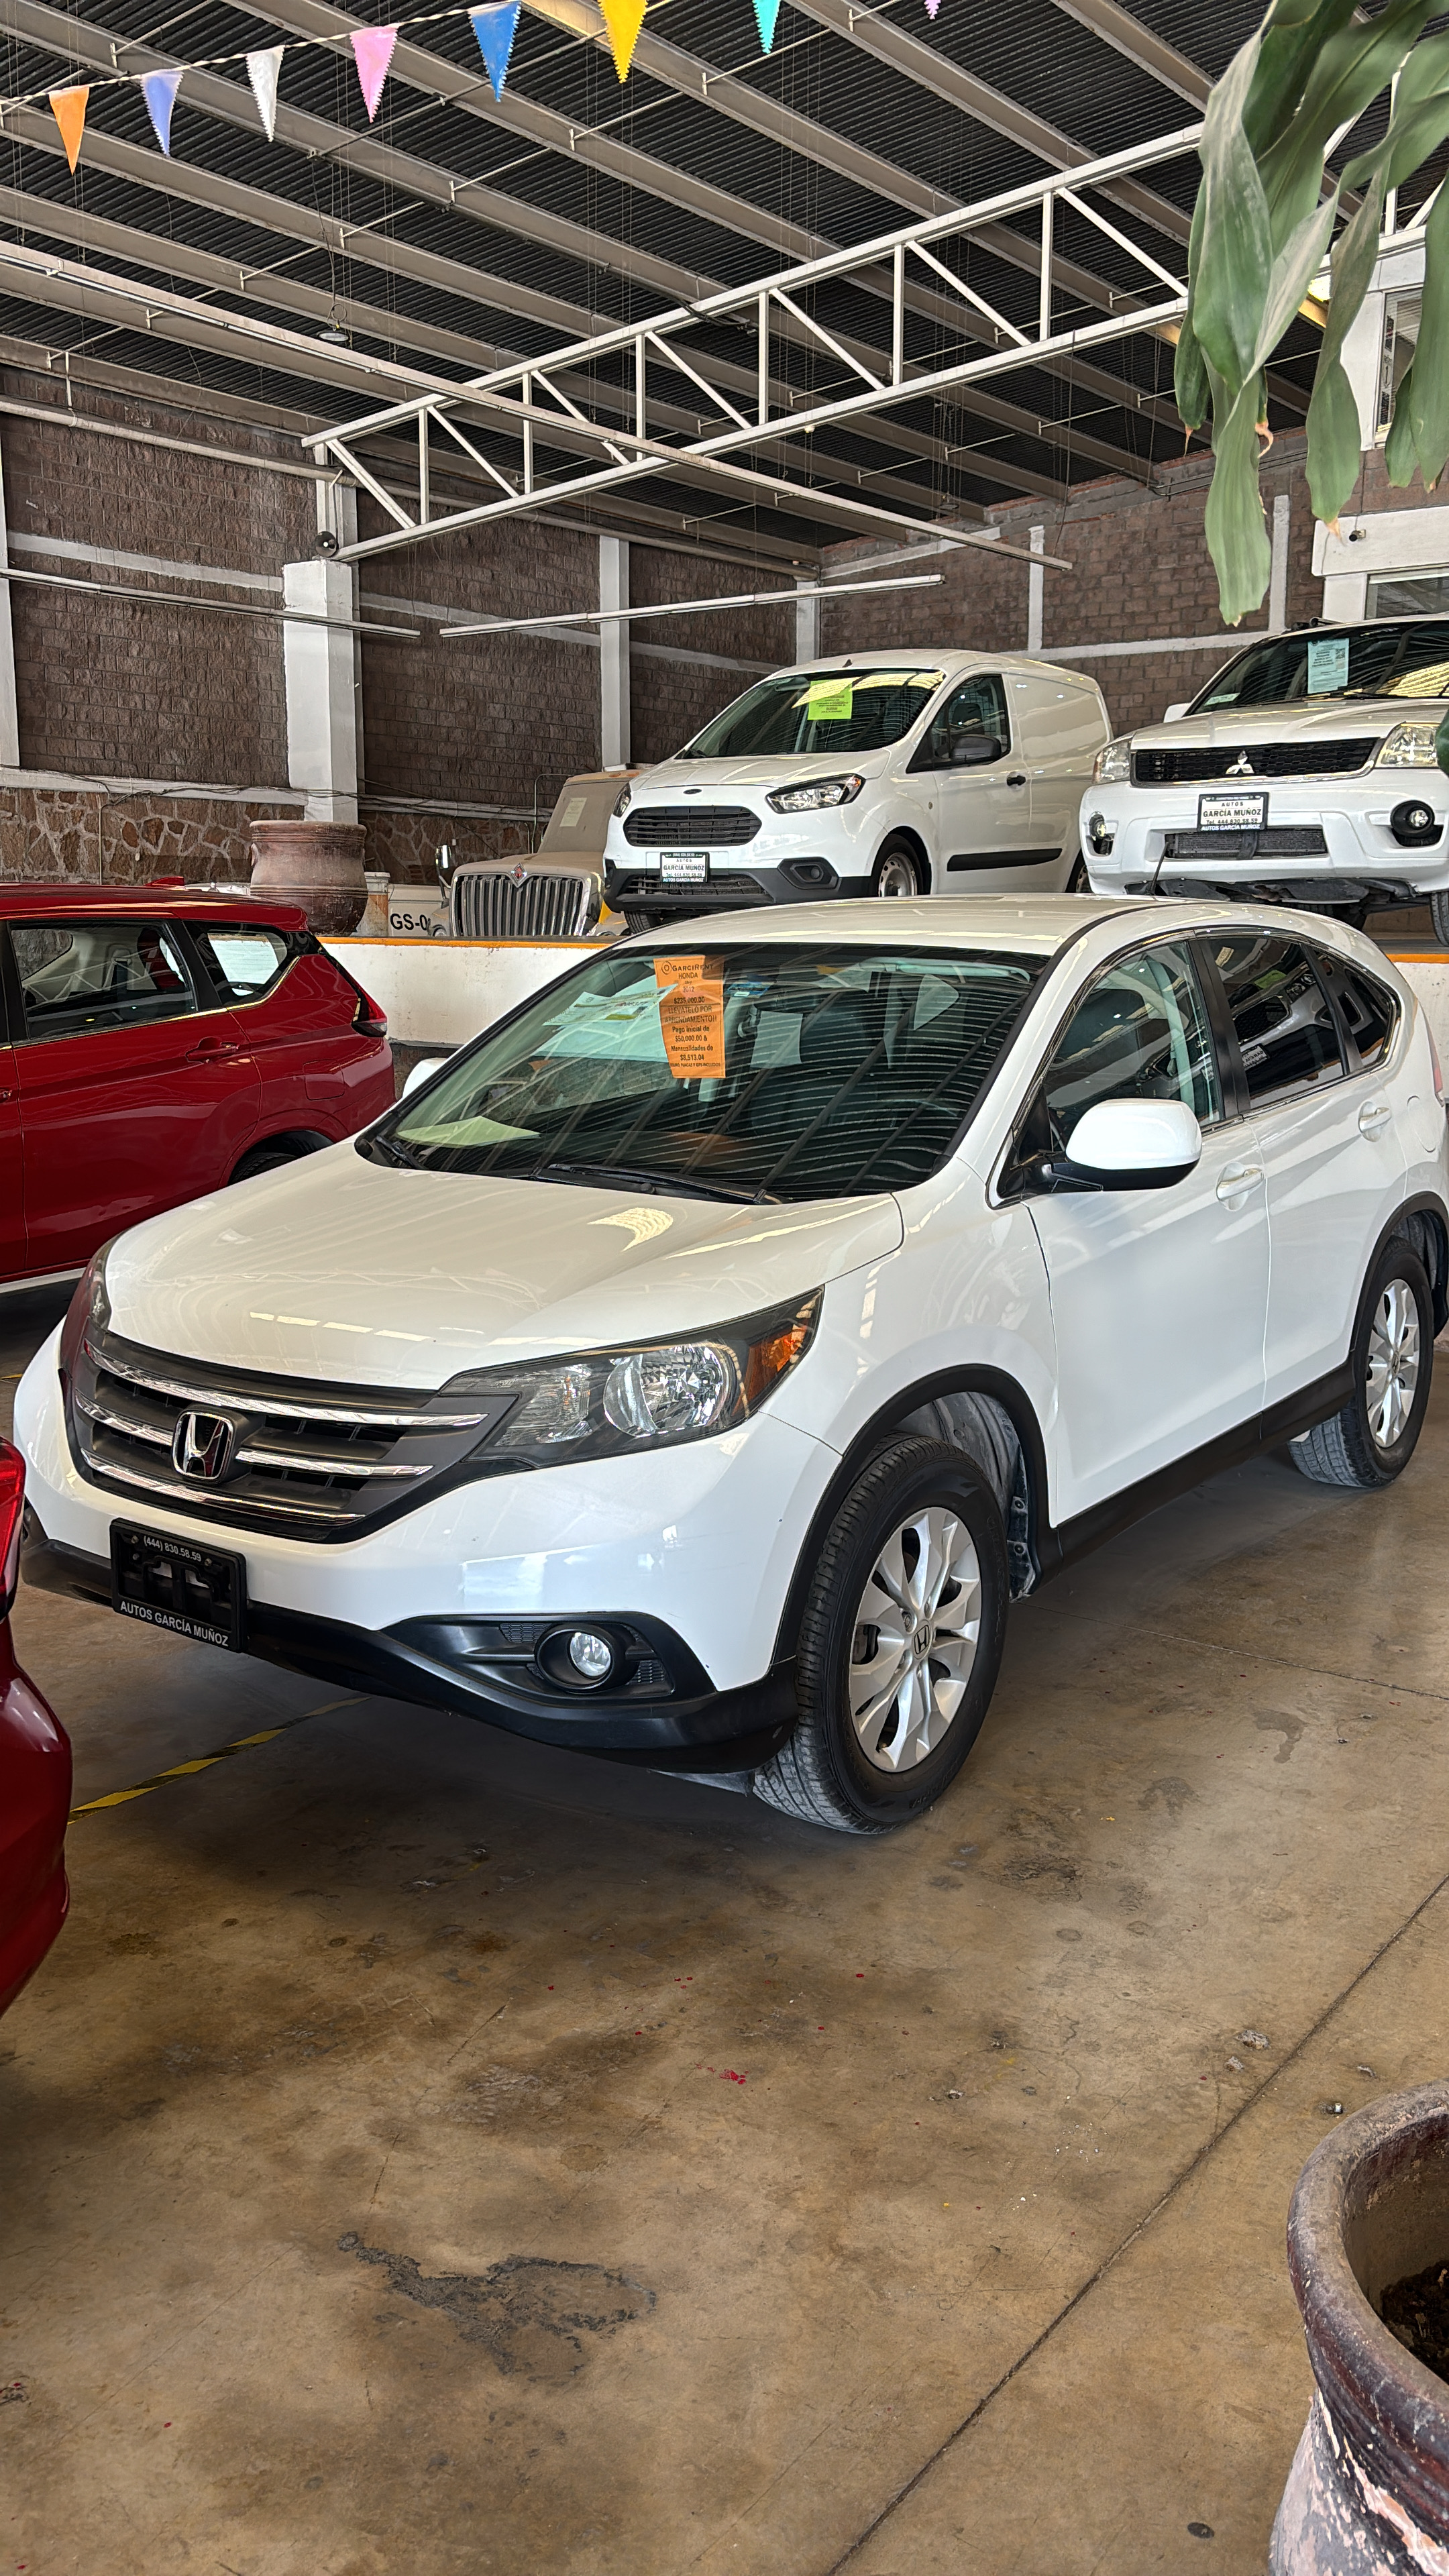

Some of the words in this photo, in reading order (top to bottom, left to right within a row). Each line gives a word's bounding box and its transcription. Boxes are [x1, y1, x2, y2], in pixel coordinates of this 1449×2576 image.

[1203, 808, 1232, 817] GARCÍA
[1234, 808, 1262, 816] MUÑOZ
[143, 1536, 163, 1552] (444)
[164, 1542, 202, 1562] 830.58.59
[120, 1601, 153, 1621] AUTOS
[154, 1612, 193, 1634] GARCÍA
[193, 1625, 229, 1647] MUÑOZ
